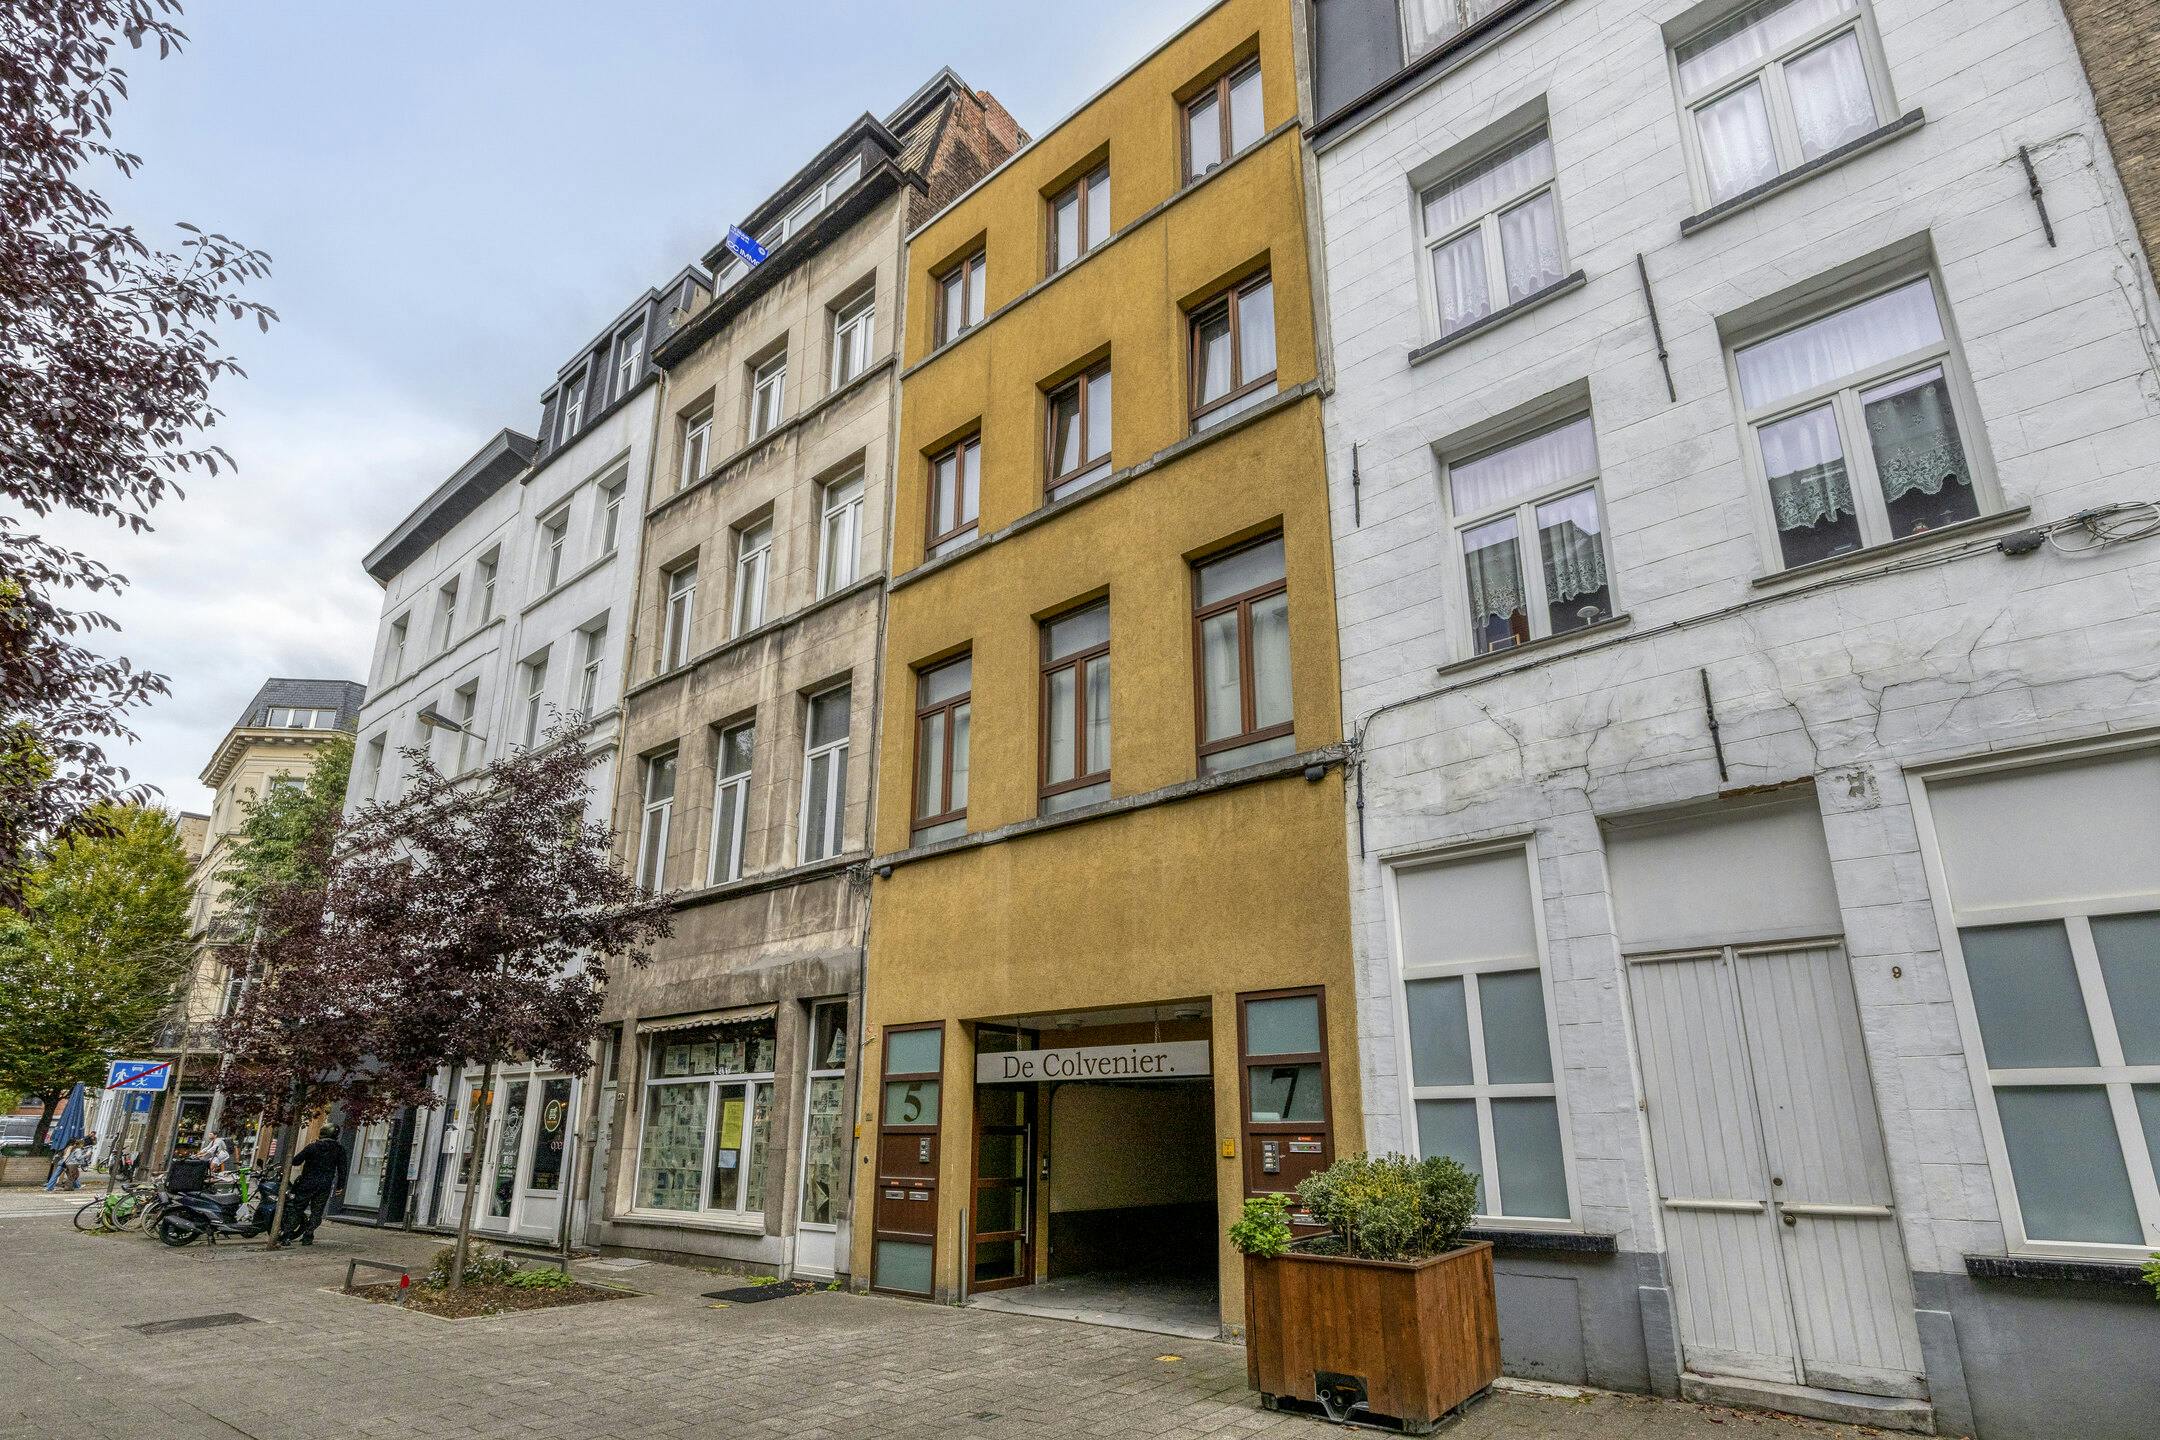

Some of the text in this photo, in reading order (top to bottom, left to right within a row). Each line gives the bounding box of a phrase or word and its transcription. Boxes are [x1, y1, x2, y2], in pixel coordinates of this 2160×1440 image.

[1892, 966, 1902, 979] 9
[1003, 1048, 1175, 1078] De Colvenier.
[903, 1081, 922, 1122] 5
[1271, 1067, 1300, 1119] 7
